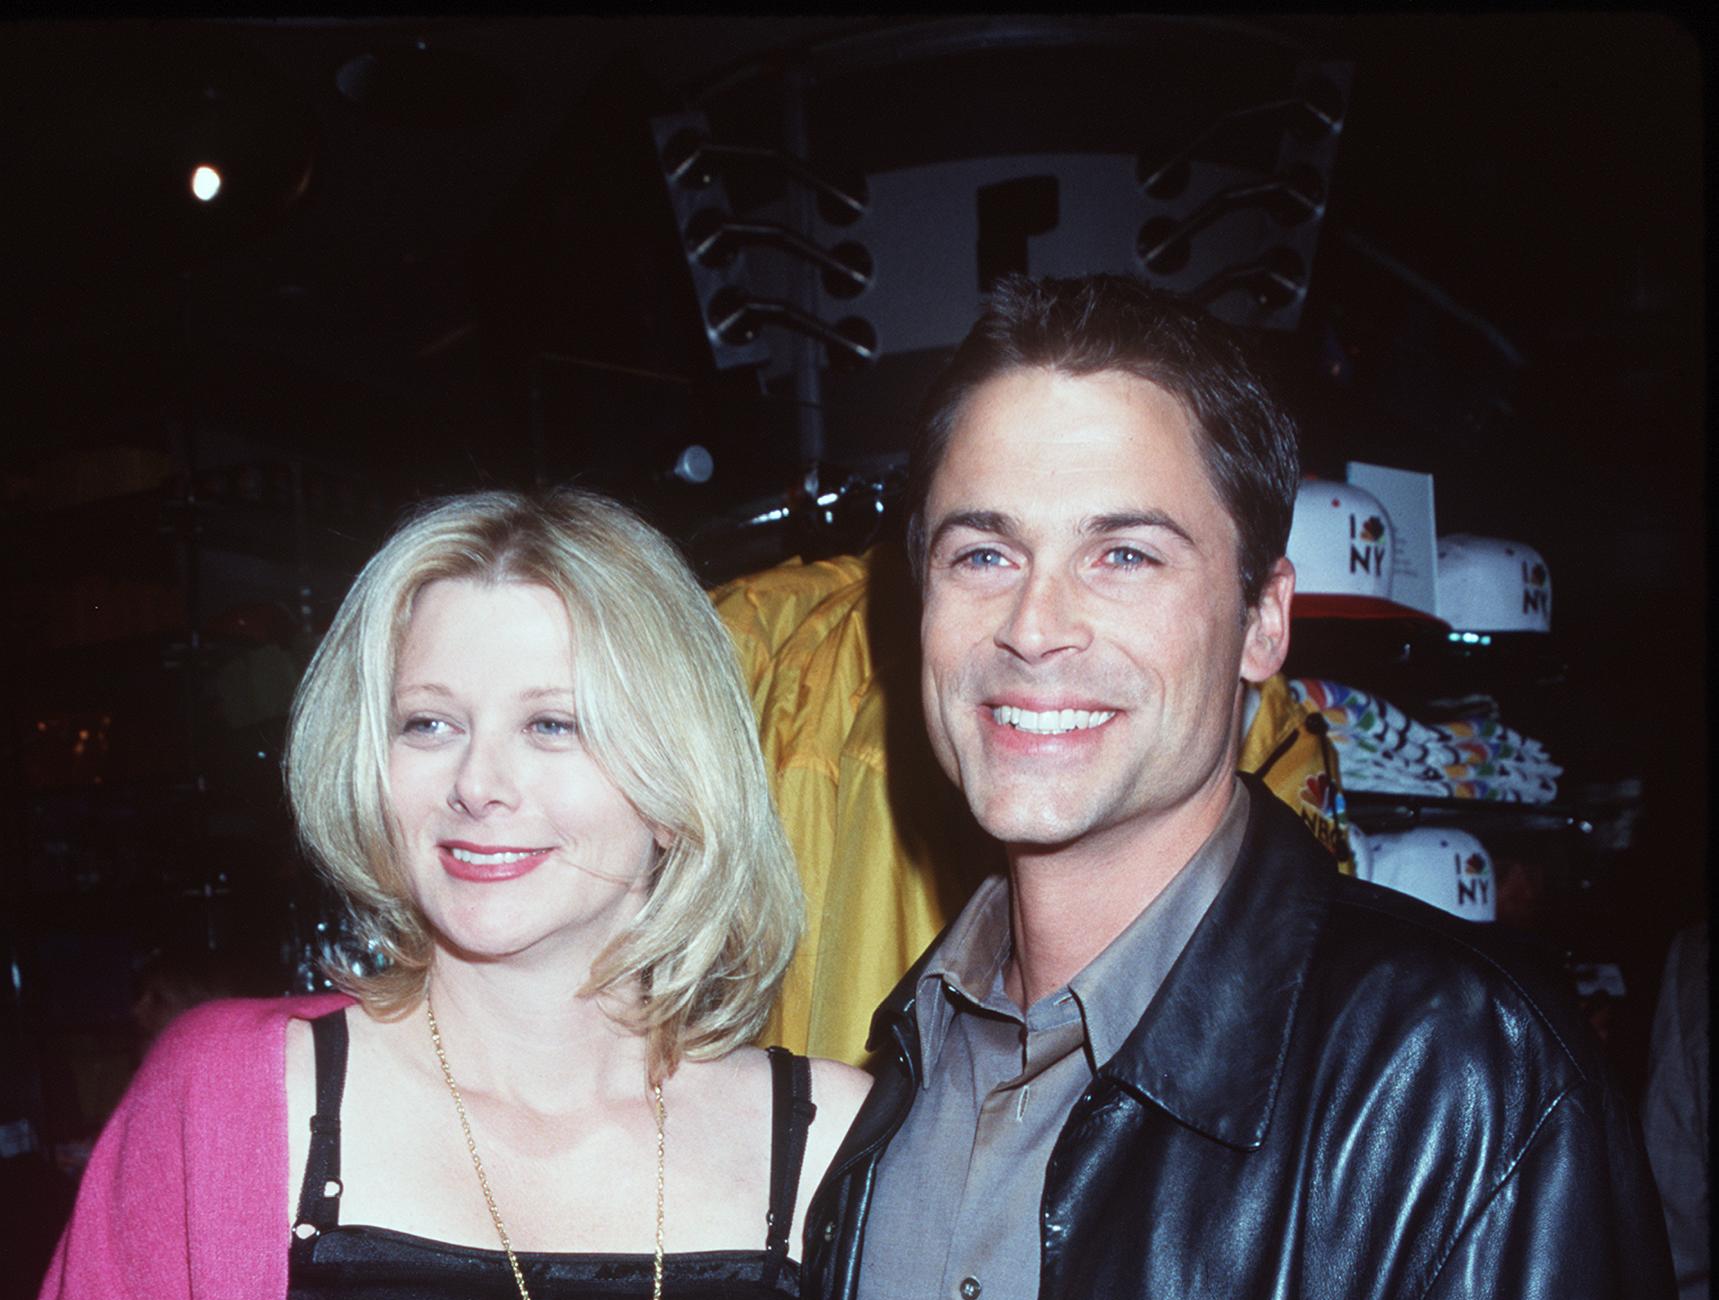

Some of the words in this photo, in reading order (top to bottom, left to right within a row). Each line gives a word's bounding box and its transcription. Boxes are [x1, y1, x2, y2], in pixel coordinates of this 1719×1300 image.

[1349, 545, 1386, 577] NY
[1522, 588, 1550, 617] NY
[1458, 879, 1489, 905] NY
